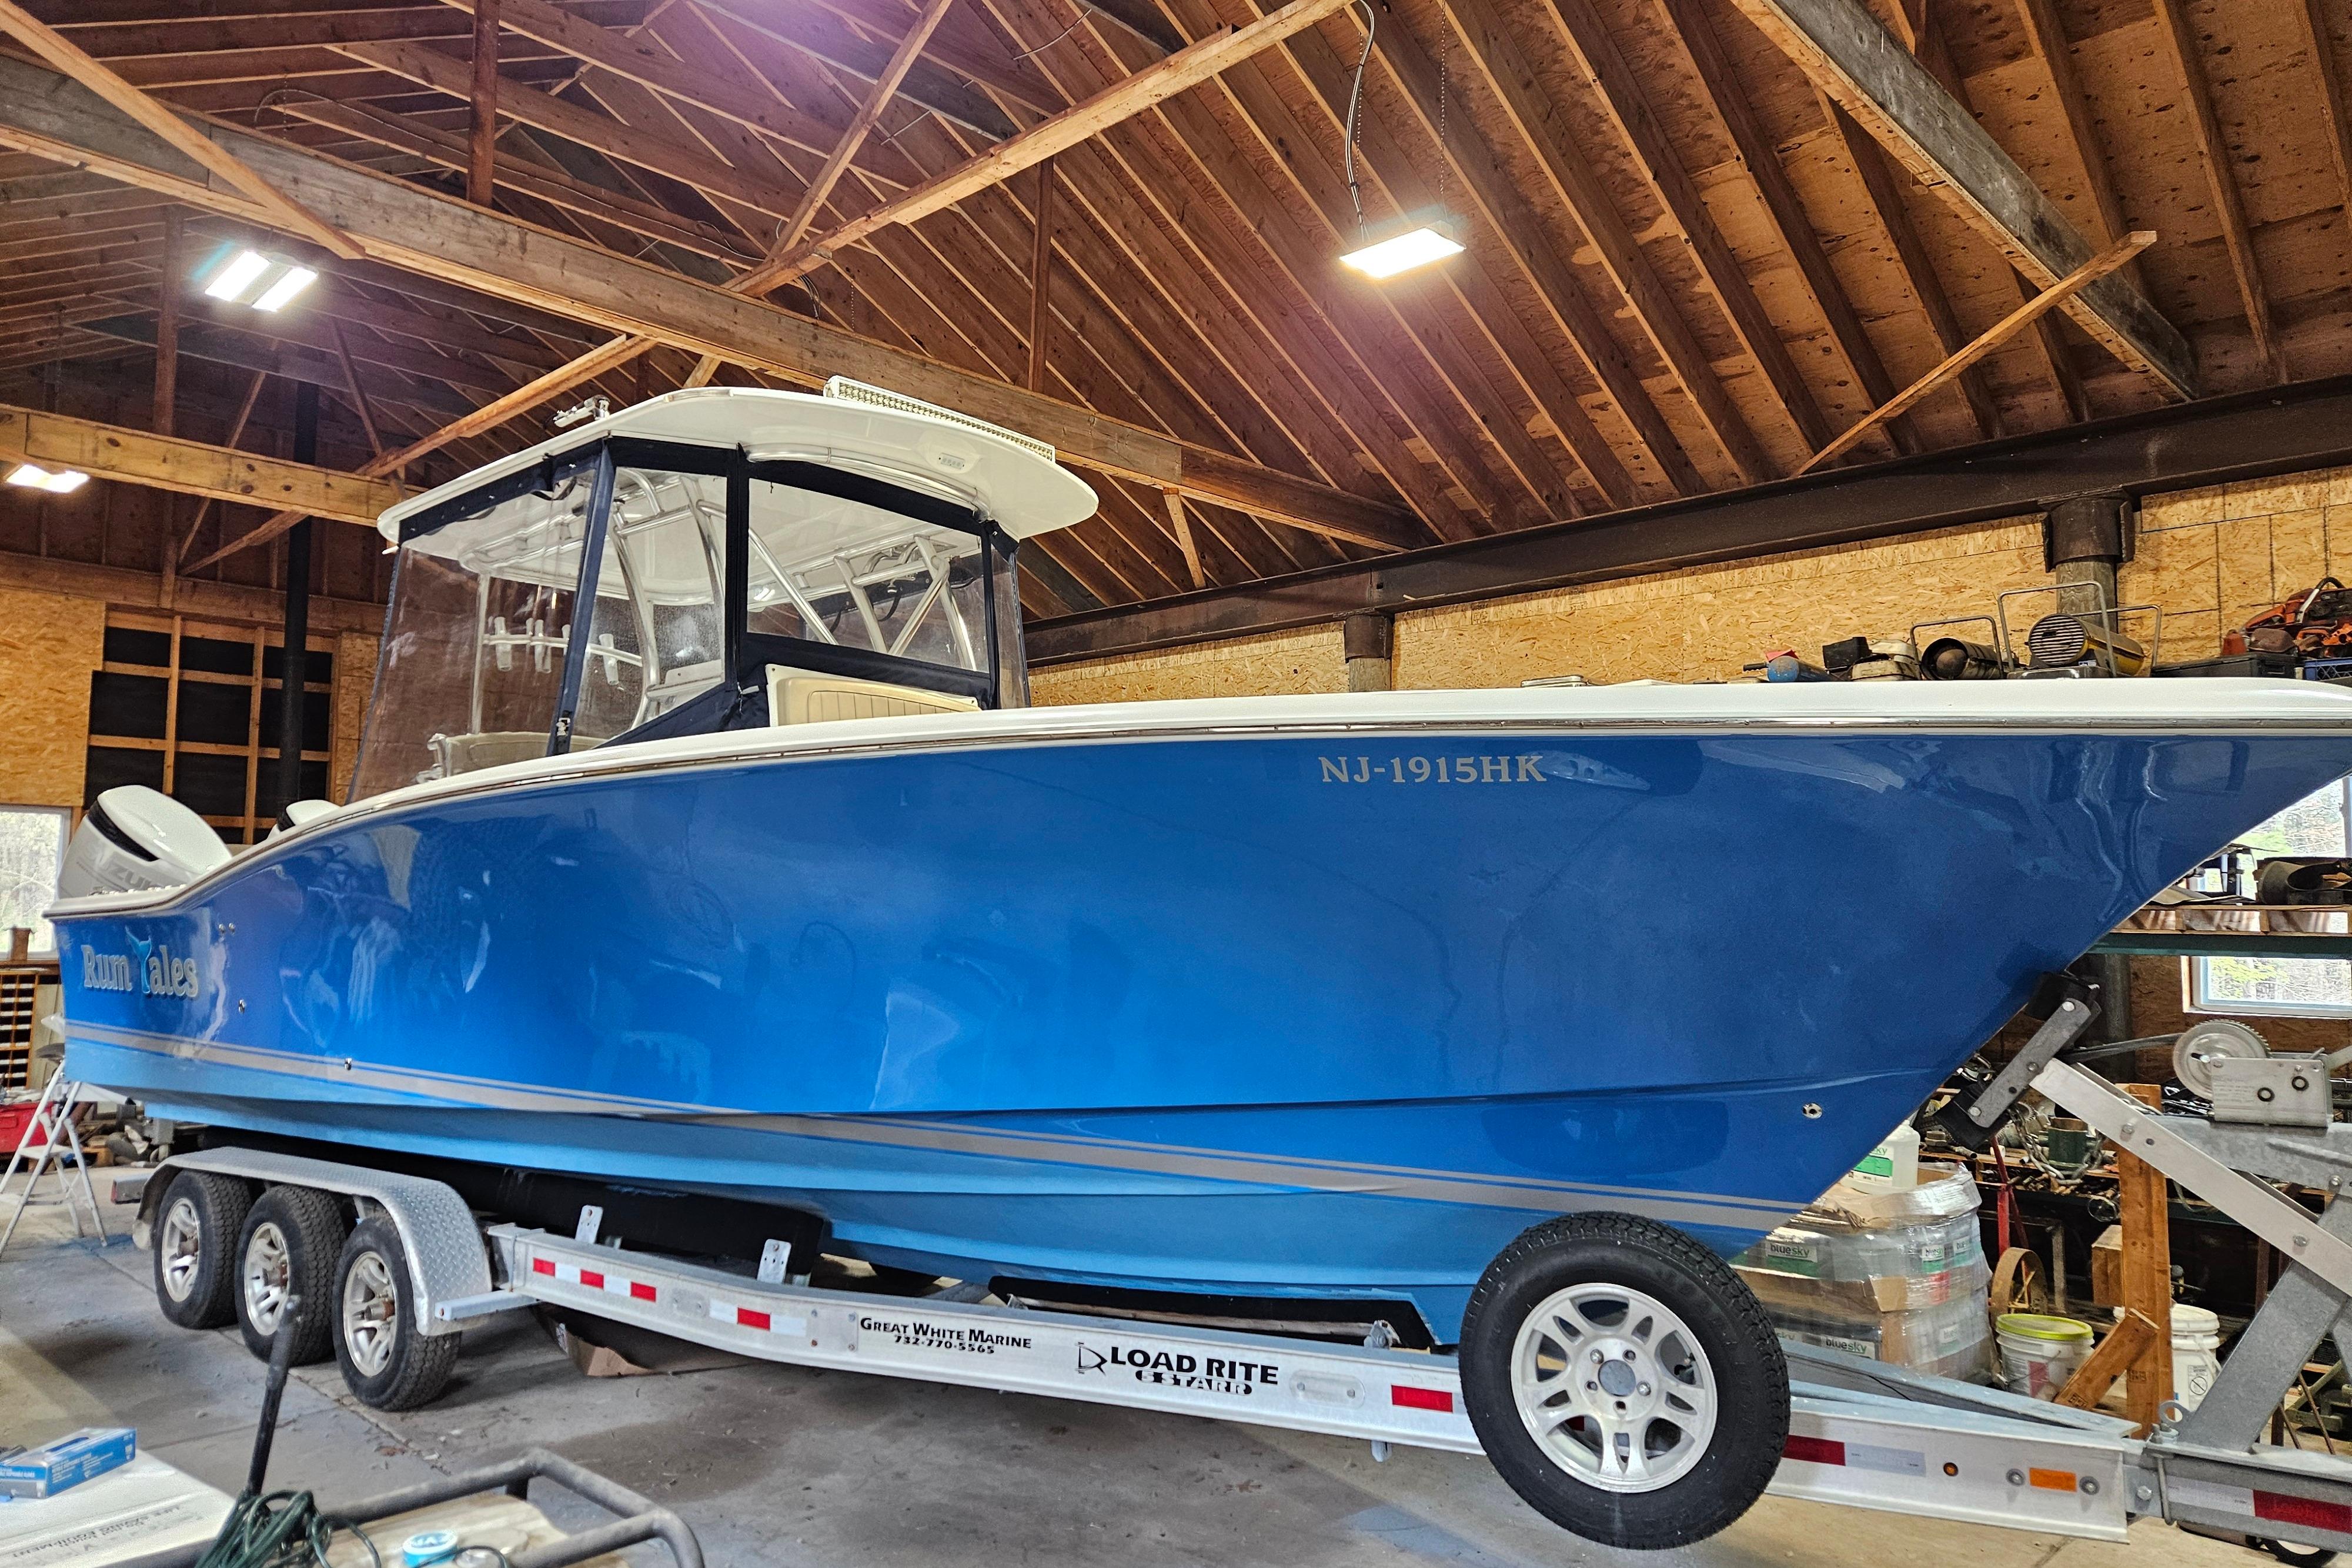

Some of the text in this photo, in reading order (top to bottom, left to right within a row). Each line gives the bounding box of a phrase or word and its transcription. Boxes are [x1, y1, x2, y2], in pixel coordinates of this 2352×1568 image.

[1318, 755, 1547, 783] NJ-1915HK
[81, 944, 133, 991] Rum
[1770, 1243, 1810, 1258] bluesky
[860, 1317, 1032, 1349] GREAT WHITE MARINE
[1826, 1337, 1867, 1355] bluesky
[1111, 1346, 1279, 1385] LOAD RITE
[1161, 1372, 1252, 1396] STARR
